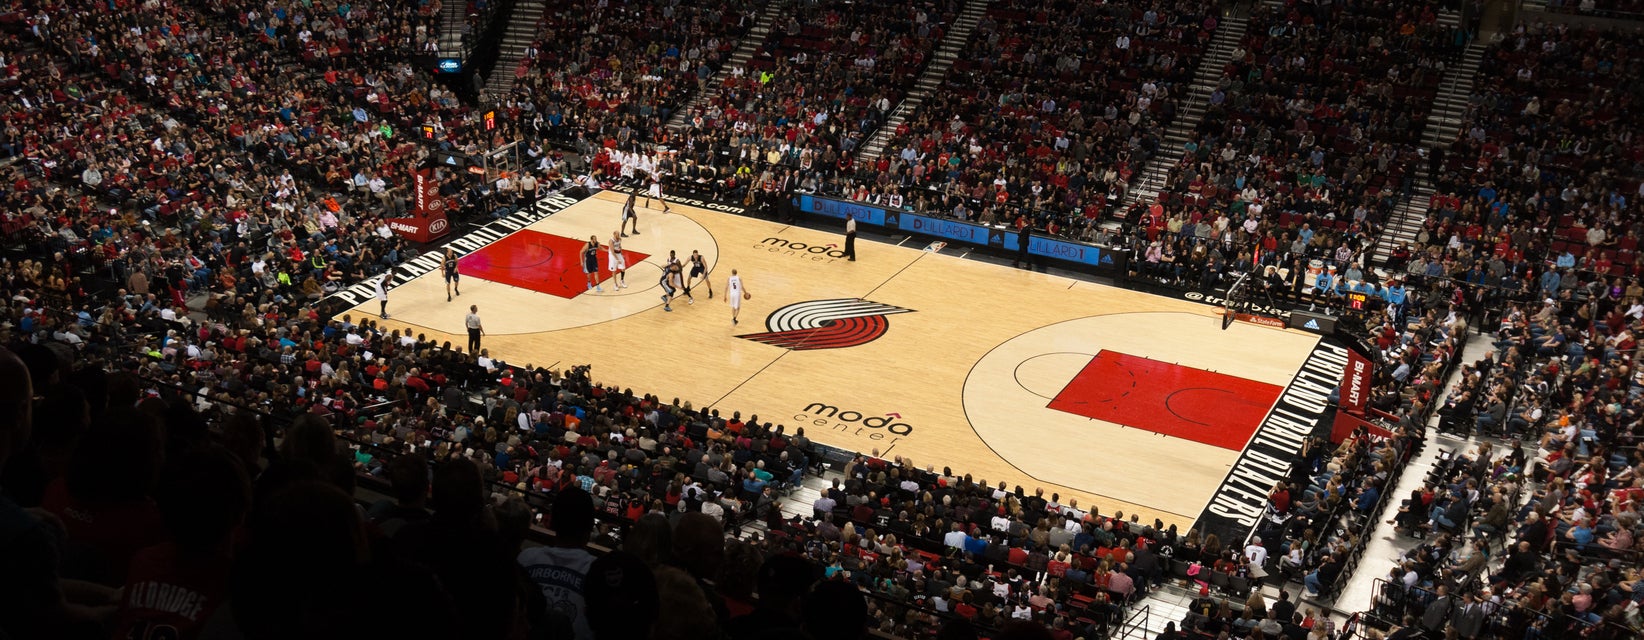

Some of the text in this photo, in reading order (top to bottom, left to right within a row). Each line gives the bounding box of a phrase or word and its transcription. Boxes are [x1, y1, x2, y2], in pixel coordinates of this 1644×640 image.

[390, 222, 419, 234] BI-MART
[441, 224, 507, 255] TRAIL
[496, 193, 578, 231] BLAERS
[753, 244, 838, 264] center
[761, 237, 846, 258] moda
[1349, 360, 1365, 407] BI-MART
[794, 414, 903, 444] center
[803, 403, 913, 436] moda
[1253, 408, 1318, 455] TRAIL
[129, 580, 208, 622] ALDRIDGE
